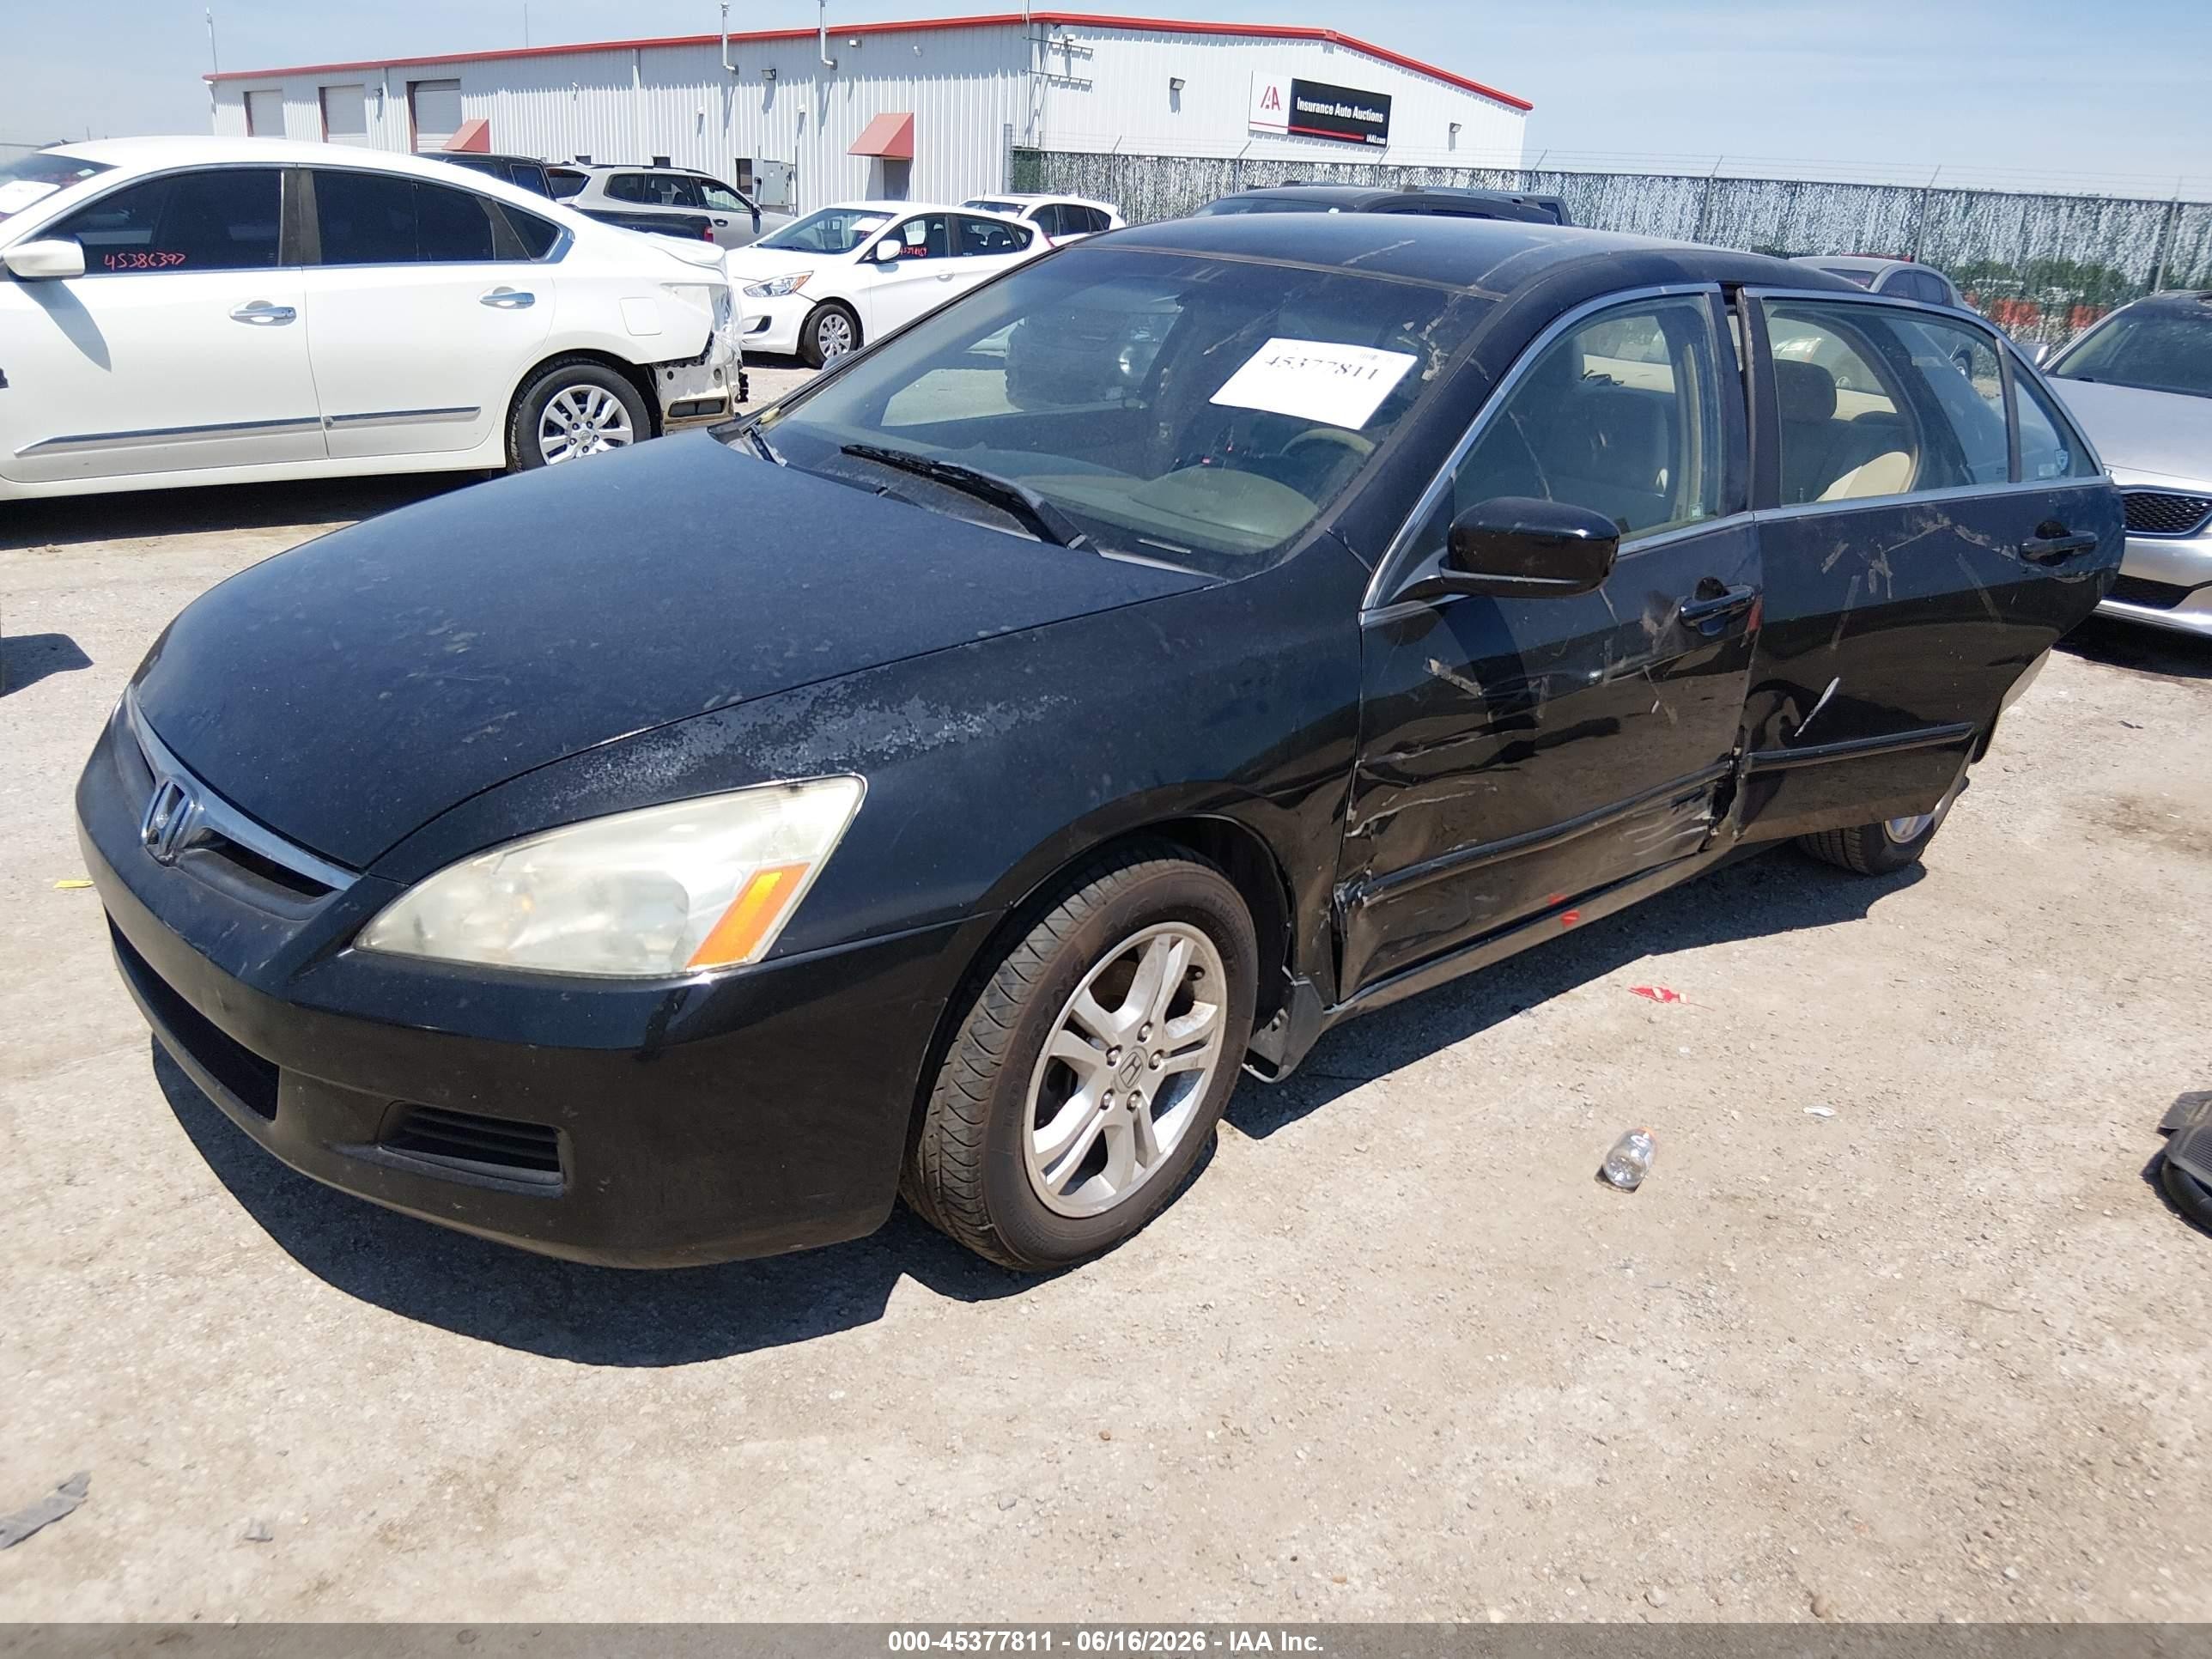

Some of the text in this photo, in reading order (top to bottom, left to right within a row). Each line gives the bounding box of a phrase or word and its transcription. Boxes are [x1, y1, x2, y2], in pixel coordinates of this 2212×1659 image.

[1297, 96, 1384, 124] Insurance Auto Auctions
[104, 252, 186, 270] 45386397
[1266, 356, 1378, 380] 45377811
